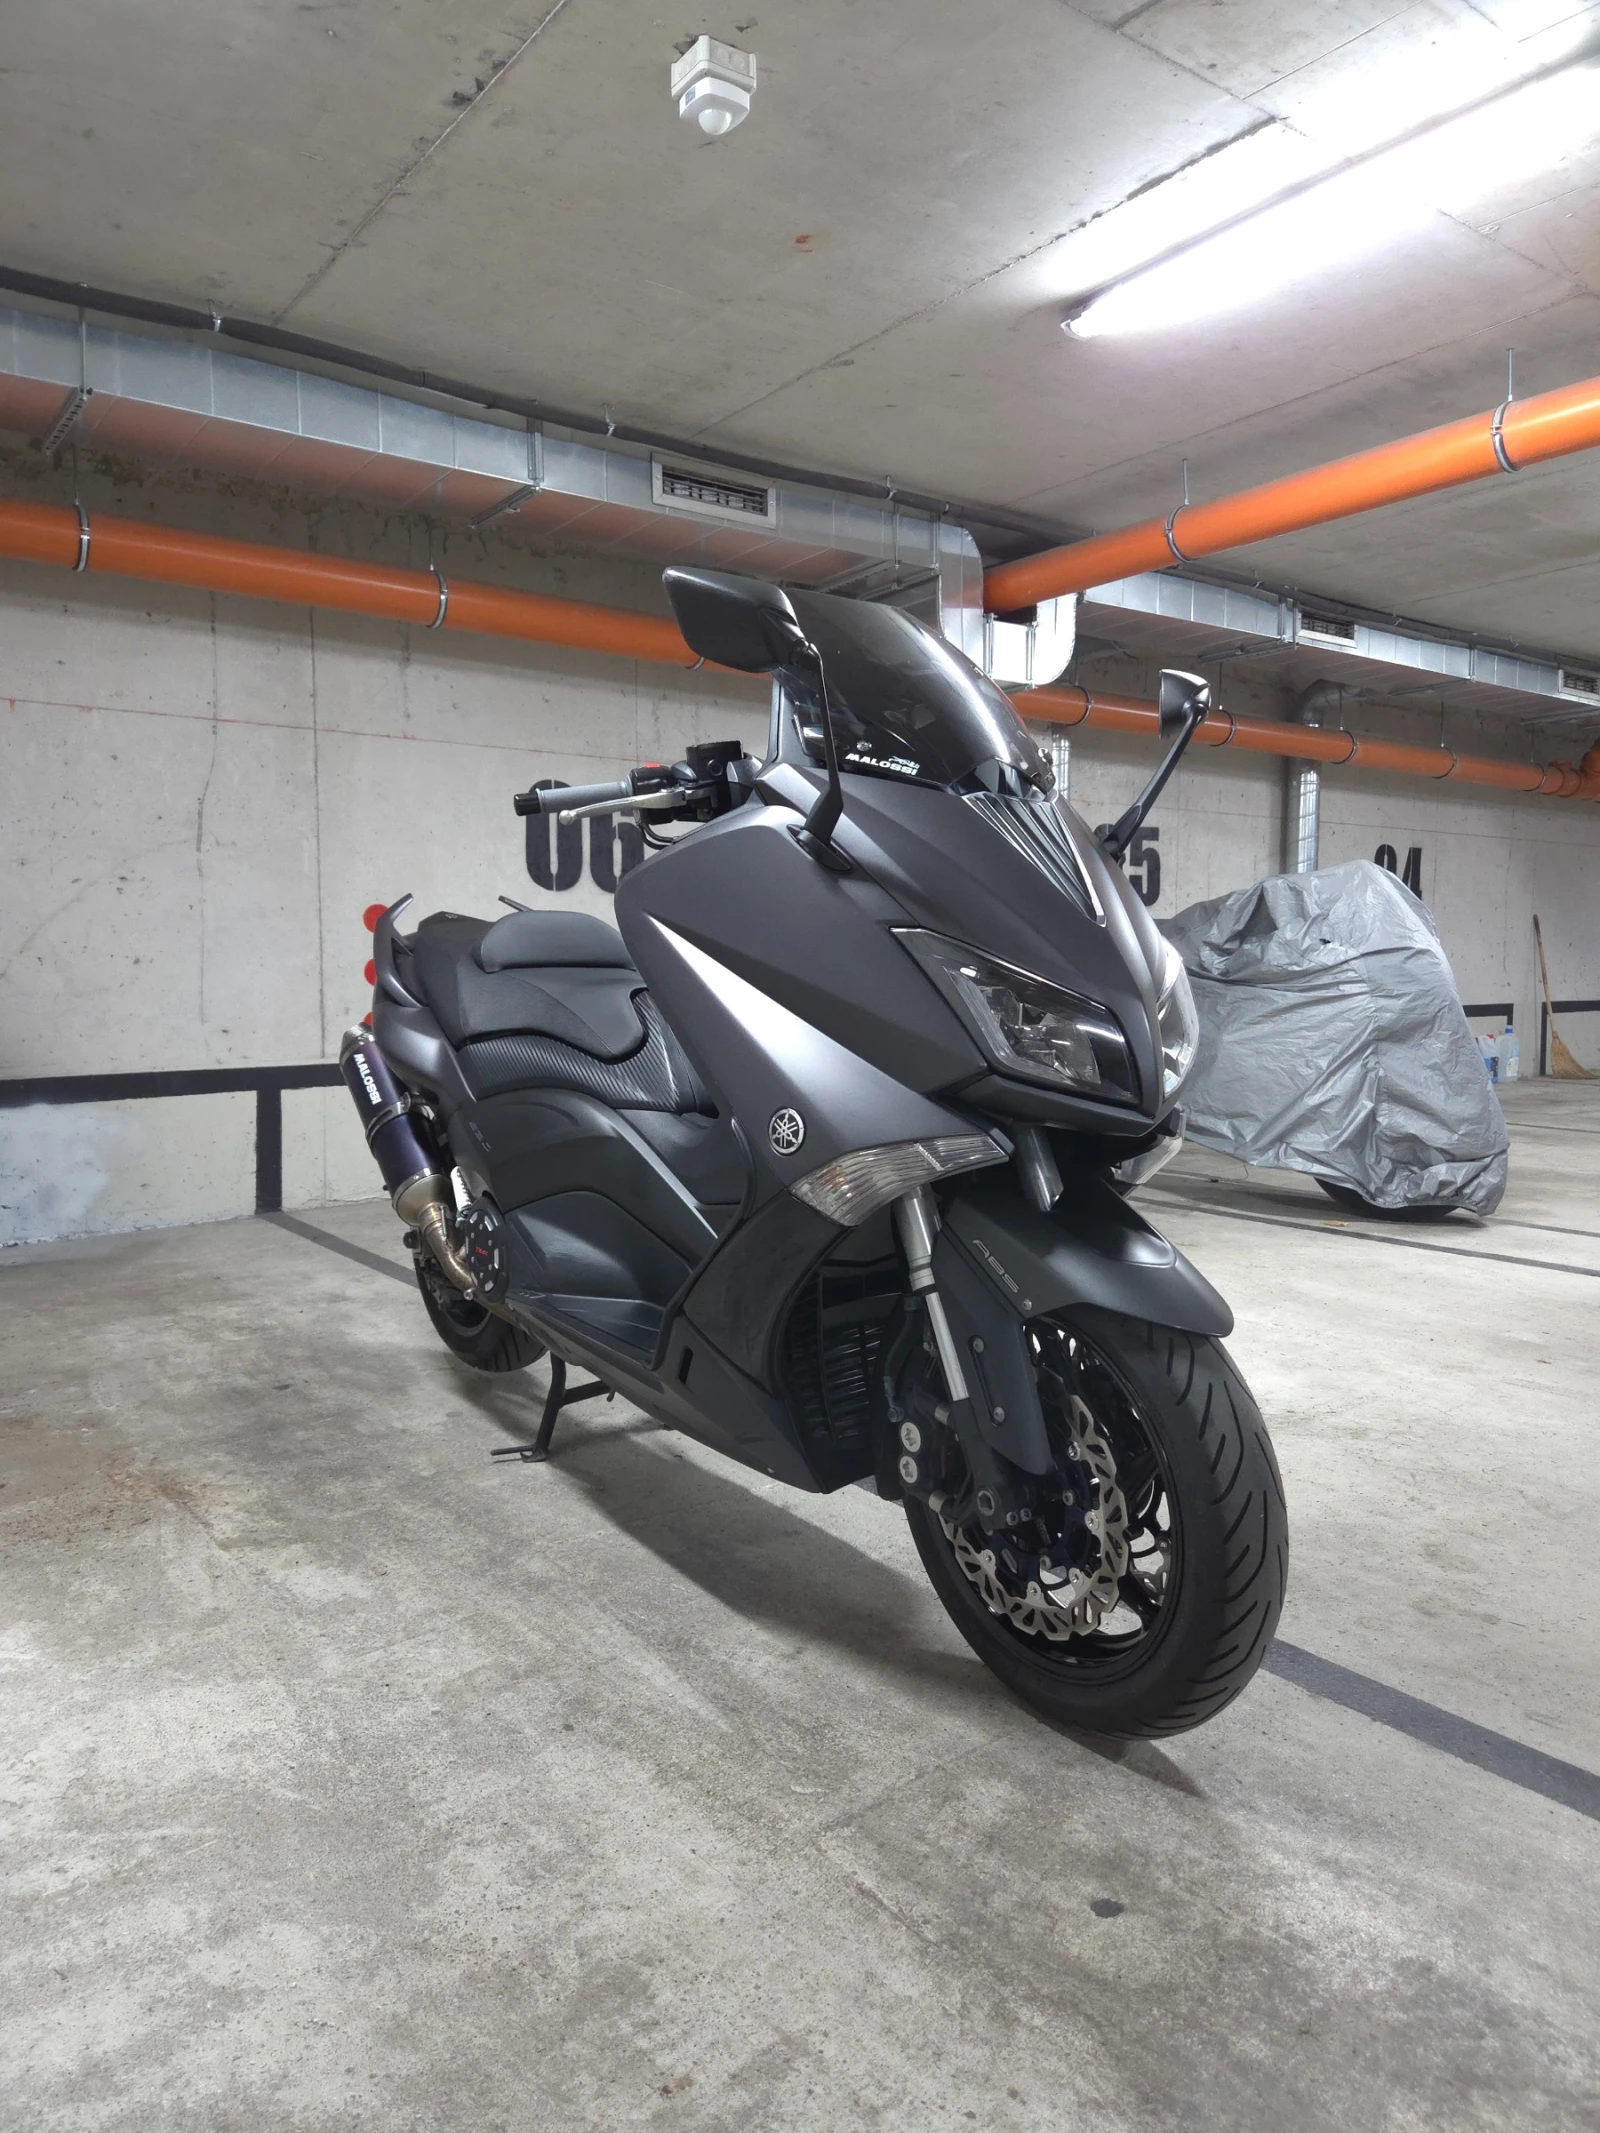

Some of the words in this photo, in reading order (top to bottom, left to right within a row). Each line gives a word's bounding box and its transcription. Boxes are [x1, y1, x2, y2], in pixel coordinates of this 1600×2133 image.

[845, 753, 918, 775] MALOSSI
[354, 1054, 382, 1104] MALOSSI
[972, 1239, 1020, 1293] ABS
